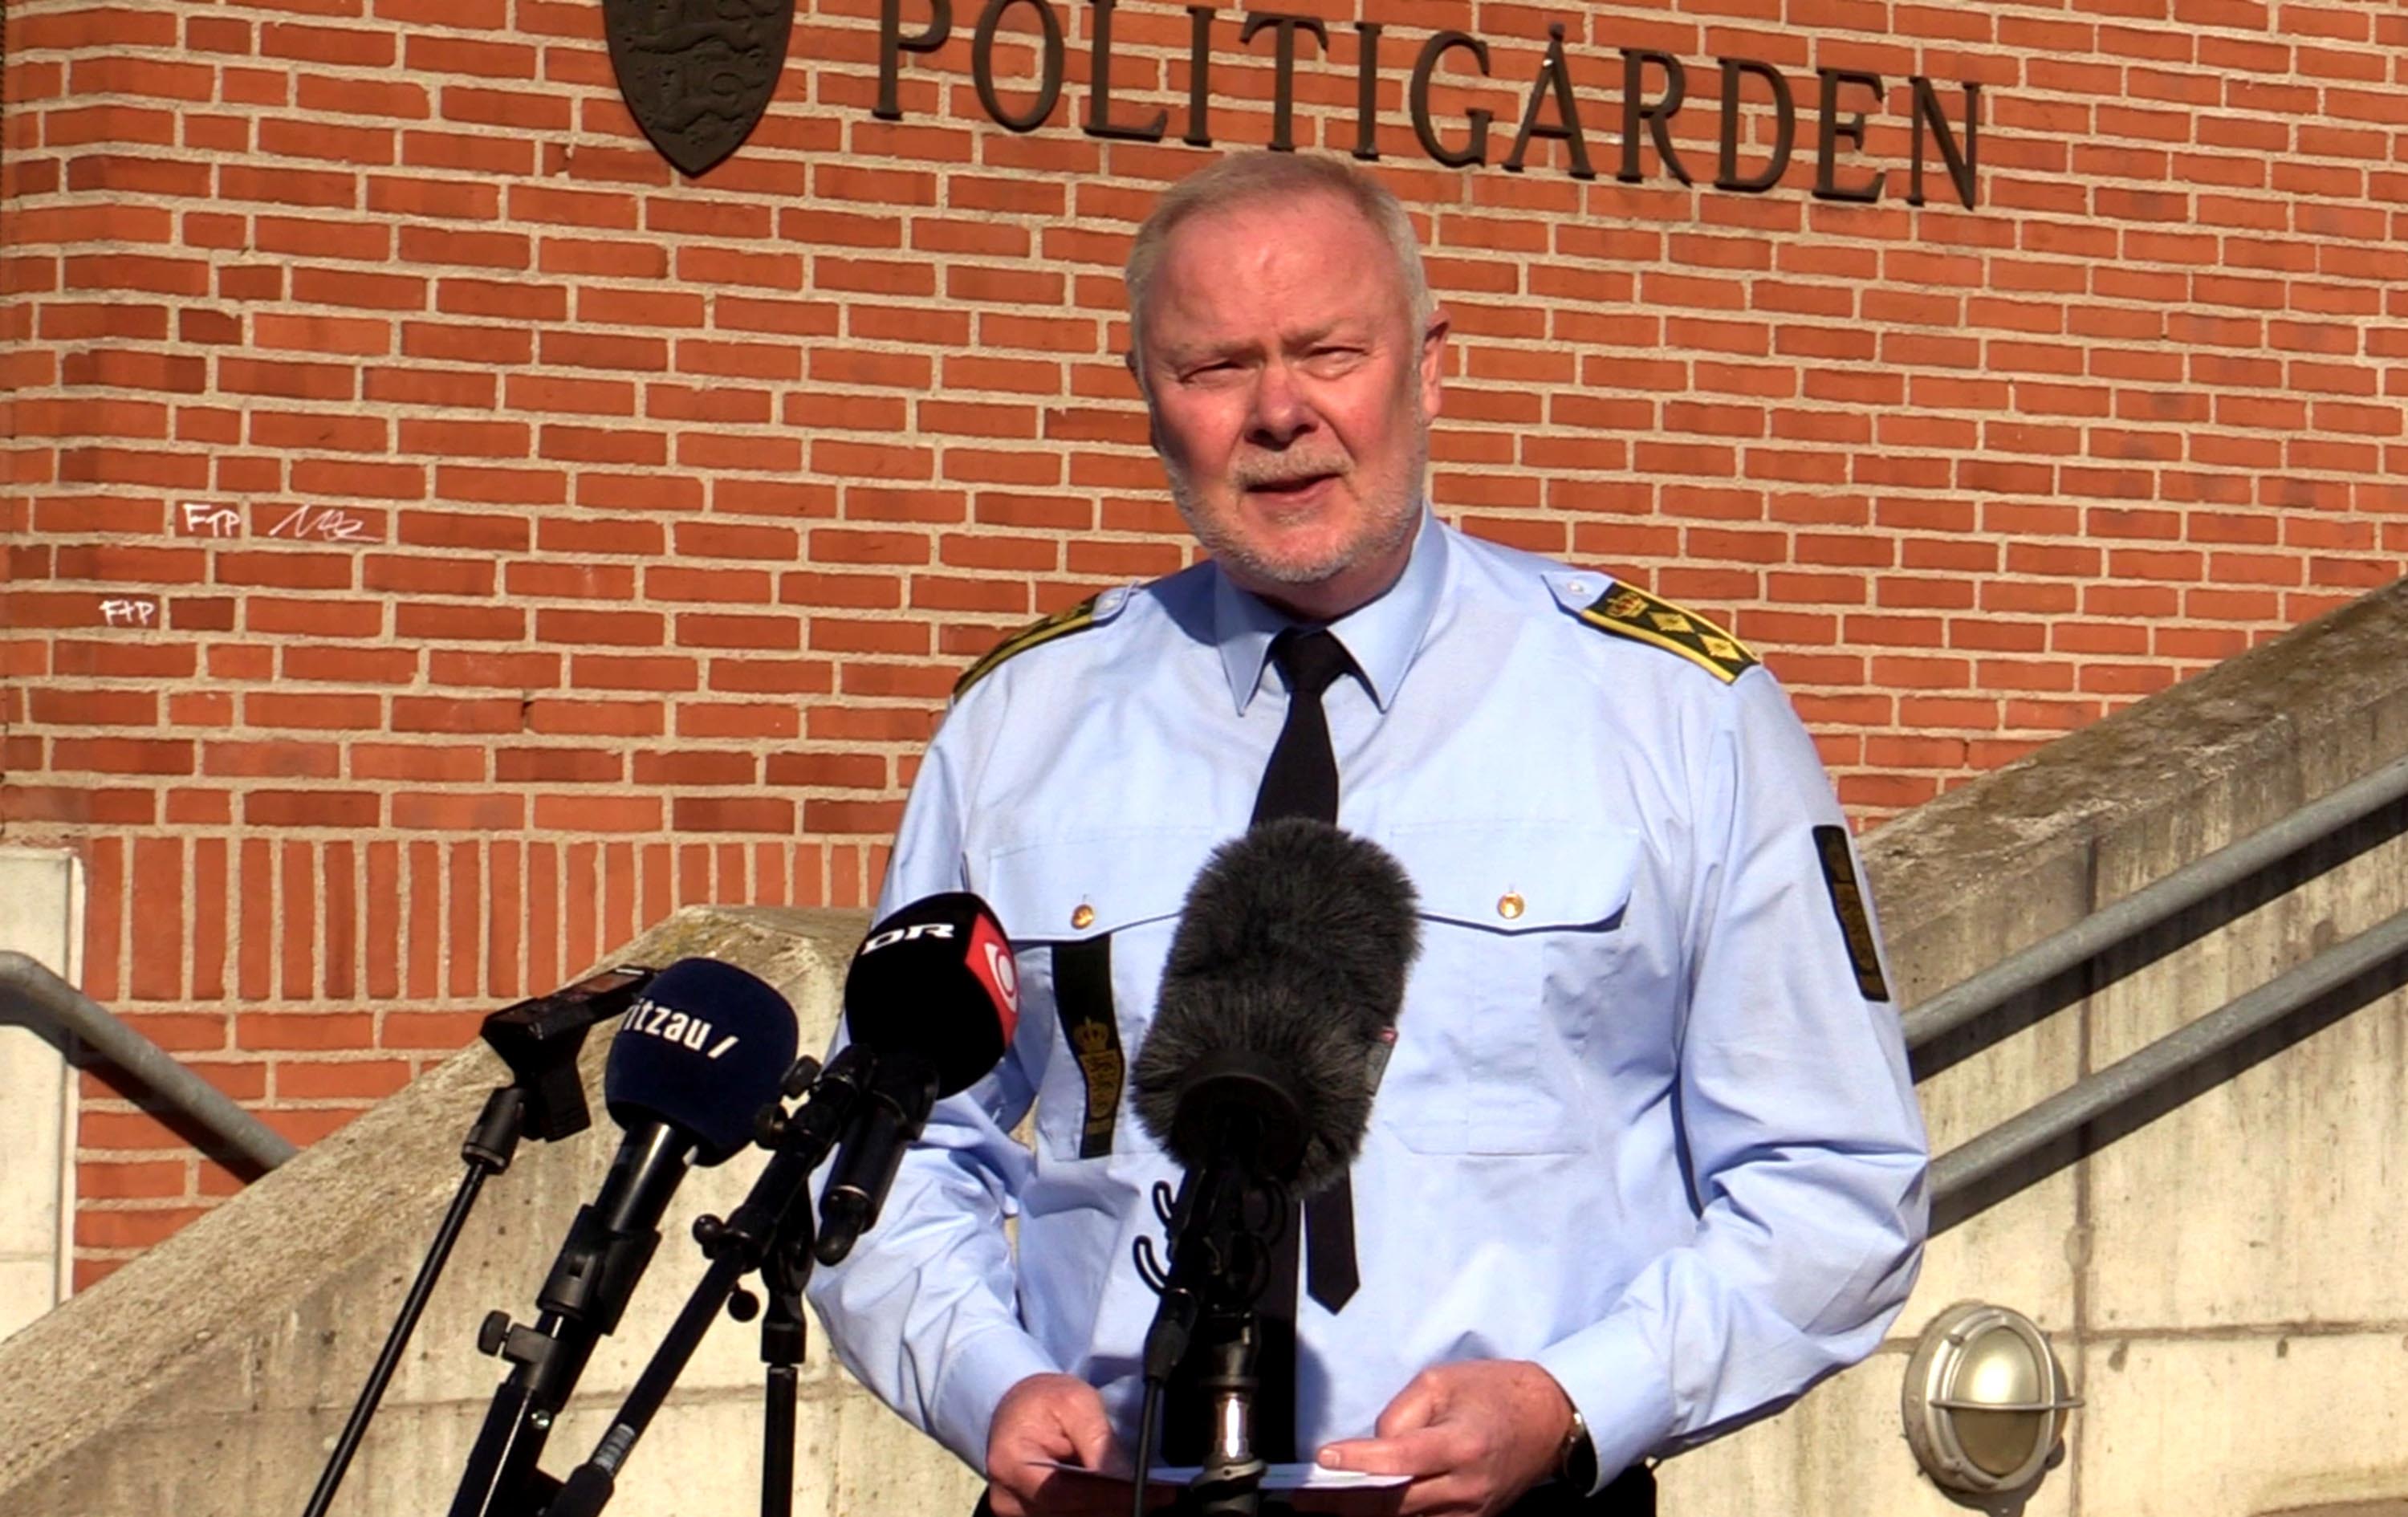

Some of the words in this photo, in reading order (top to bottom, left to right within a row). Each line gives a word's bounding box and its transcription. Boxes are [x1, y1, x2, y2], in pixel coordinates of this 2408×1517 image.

[872, 0, 1980, 211] POLITIGÅRDEN
[861, 923, 955, 955] DR
[621, 997, 713, 1051] itzau
